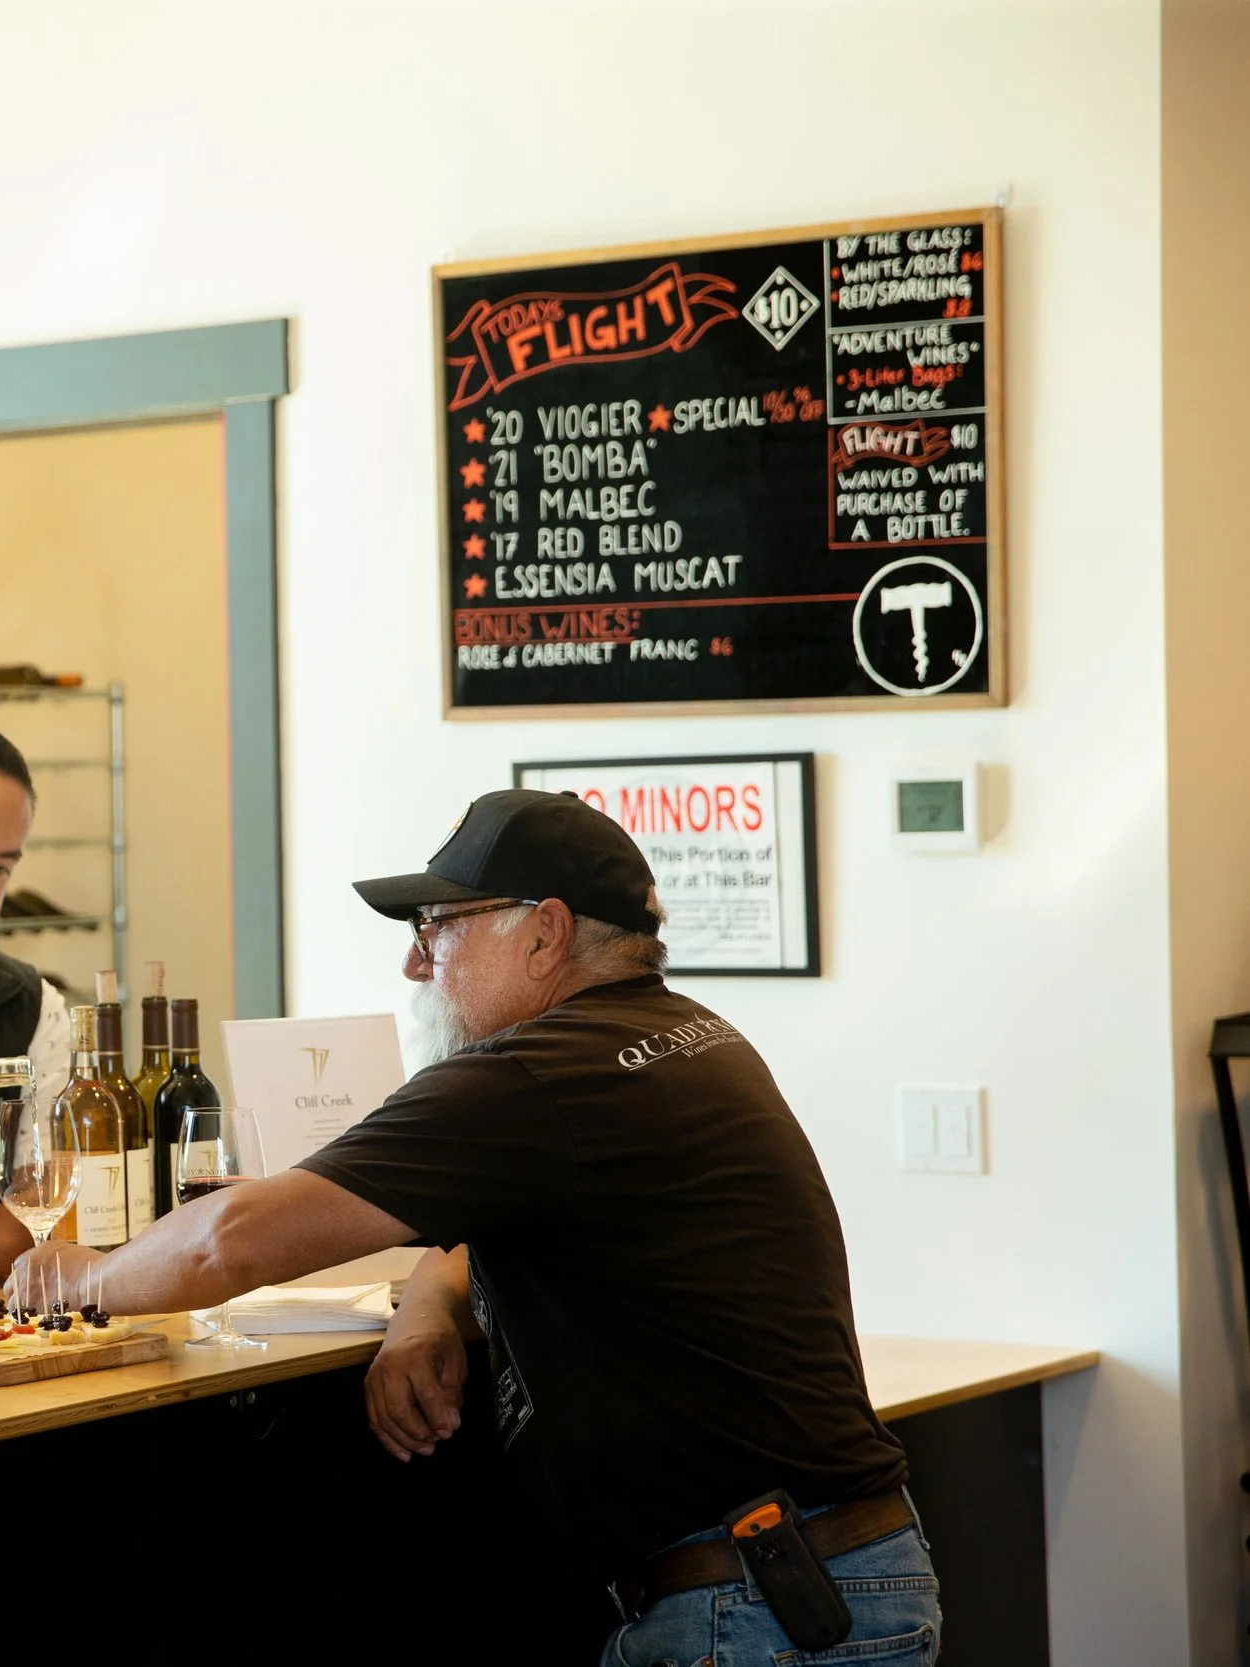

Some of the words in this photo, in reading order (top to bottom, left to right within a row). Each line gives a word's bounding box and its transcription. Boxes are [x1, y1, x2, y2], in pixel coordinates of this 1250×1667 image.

[837, 234, 861, 258] BY
[864, 231, 901, 256] THE
[906, 227, 973, 252] GLASS:
[753, 287, 799, 329] $10
[838, 274, 972, 310] RED/SPARKLING
[506, 277, 676, 372] FLIGHT
[537, 399, 643, 441] VIOGIER
[673, 396, 766, 435] SPECIAL
[842, 426, 920, 456] FLIGHT
[950, 423, 979, 449] $10
[836, 466, 918, 491] WAIVED
[927, 461, 985, 484] WITH
[539, 480, 656, 522] MALBEC
[836, 490, 927, 516] PURCHASE
[939, 489, 969, 512] OF
[537, 527, 585, 559] RED
[599, 520, 683, 557] BLEND
[850, 518, 871, 542] A
[494, 562, 617, 599] ESSENSIA
[634, 555, 743, 593] MUSCAT
[455, 611, 533, 641] BONUS
[521, 641, 617, 668] CABERNET
[629, 638, 699, 661] FRANC
[620, 784, 763, 834] MINORS
[650, 846, 683, 862] This
[688, 846, 750, 862] Portion
[755, 846, 772, 862] of
[703, 870, 737, 887] This
[742, 870, 772, 887] Bar
[321, 1093, 353, 1107] Creek
